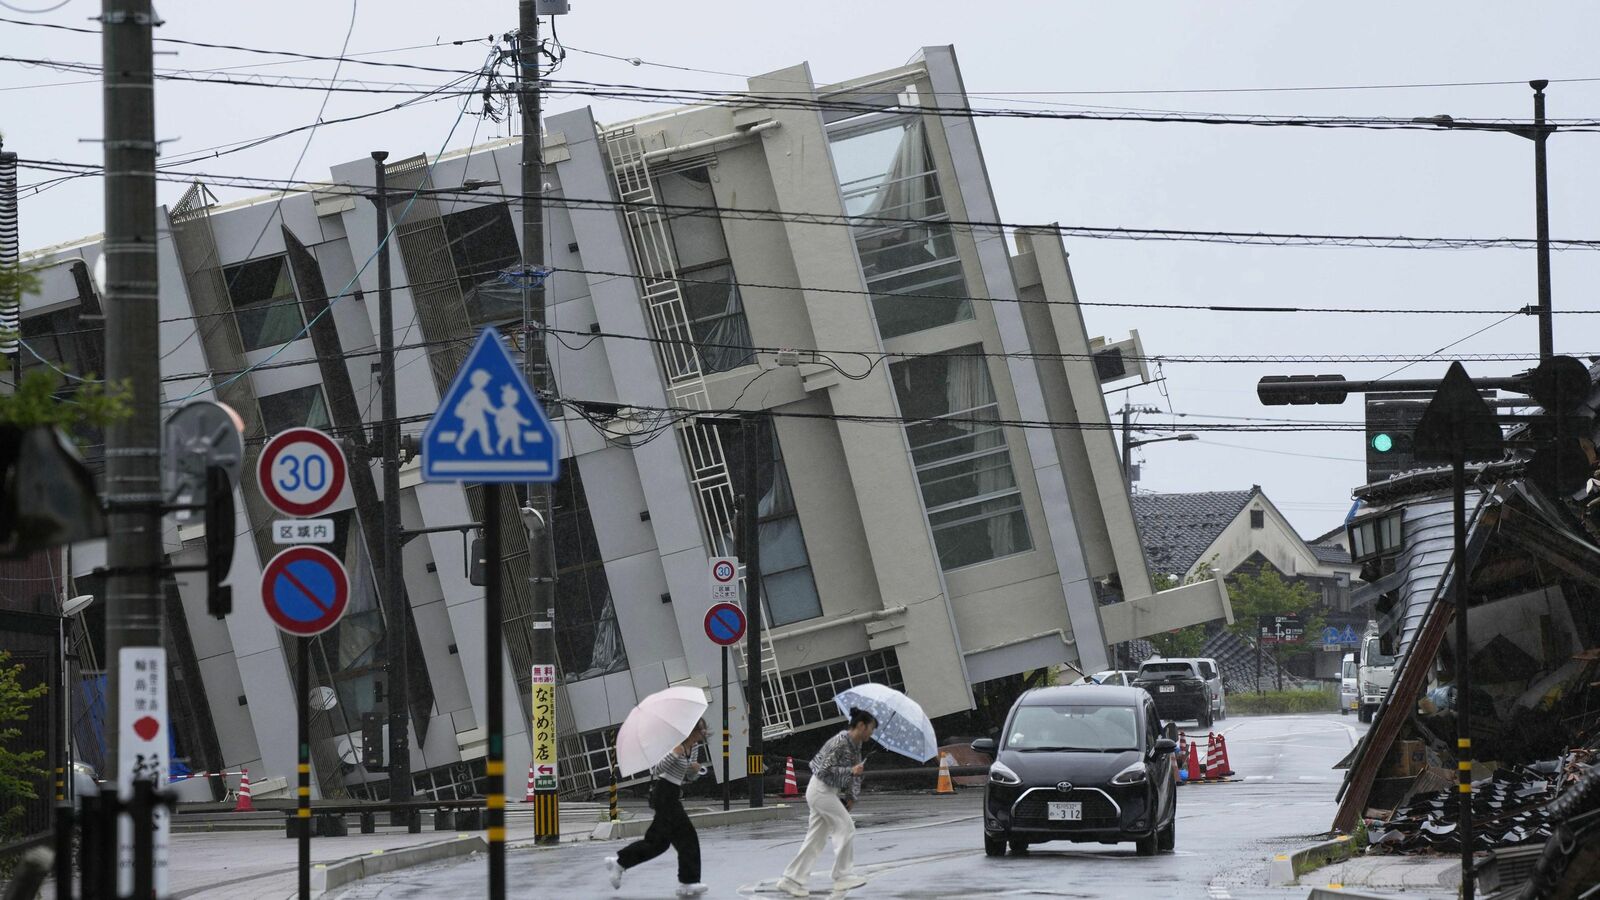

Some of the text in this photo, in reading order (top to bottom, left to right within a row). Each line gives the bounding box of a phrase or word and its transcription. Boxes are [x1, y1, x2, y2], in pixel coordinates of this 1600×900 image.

[280, 454, 326, 492] 30
[280, 525, 327, 539] 区域内
[718, 566, 731, 577] 30
[534, 667, 553, 676] 無料
[536, 688, 549, 760] なつめの店
